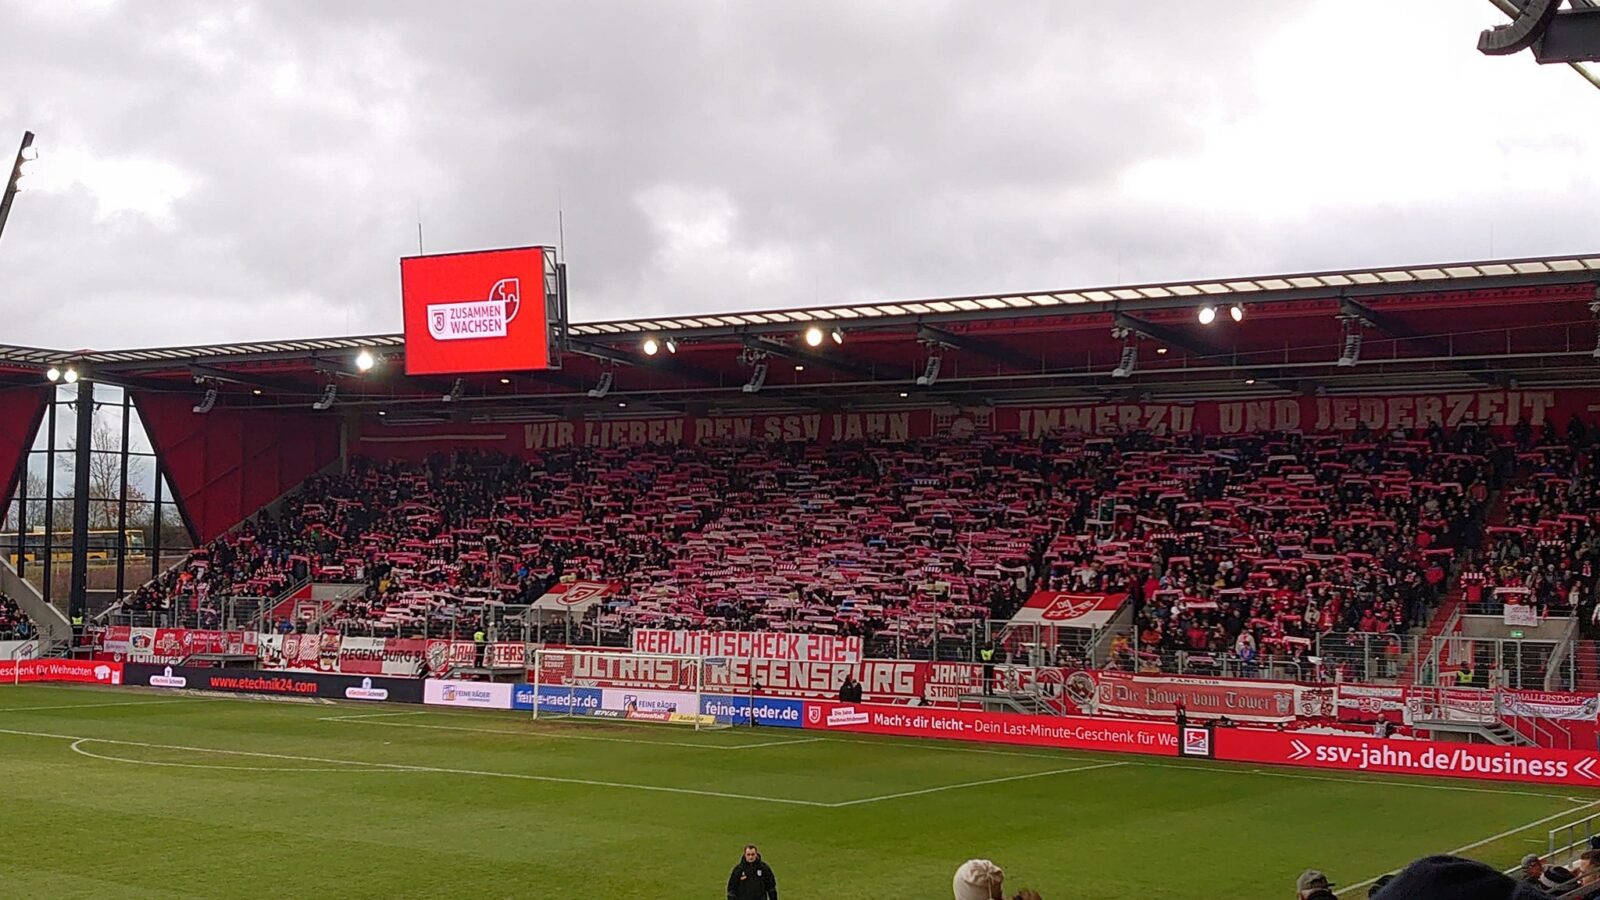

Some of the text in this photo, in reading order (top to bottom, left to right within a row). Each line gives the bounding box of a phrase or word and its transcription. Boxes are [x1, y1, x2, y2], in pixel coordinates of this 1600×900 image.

[450, 306, 501, 319] ZUSAMMEN
[450, 319, 502, 334] WACHSEN
[524, 391, 1555, 449] WIR LIEBEN DEN SSV JAHN IMMERZU UND JEDERZEIT
[341, 647, 412, 664] REGENSBURG
[636, 631, 861, 663] REALITÄTSCHECK 2024
[36, 665, 48, 675] für
[50, 665, 92, 676] Weihnachten
[573, 651, 915, 695] ULTRAS REGENSBURG
[931, 664, 971, 684] JAHN
[210, 676, 317, 693] www.etechnik24.com
[638, 700, 677, 709] FEINE RÄDER
[1115, 685, 1271, 710] Die Power vom Tower
[706, 701, 799, 720] feine-raeder.de
[874, 713, 911, 727] Mach's
[913, 716, 929, 728] dir
[931, 716, 964, 731] leicht
[975, 720, 1000, 733] Dein
[1004, 722, 1134, 743] Last-Minute-Geschenk
[1137, 730, 1155, 745] für
[1157, 733, 1178, 747] We
[1316, 743, 1568, 778] ssv-jahn.de/business
